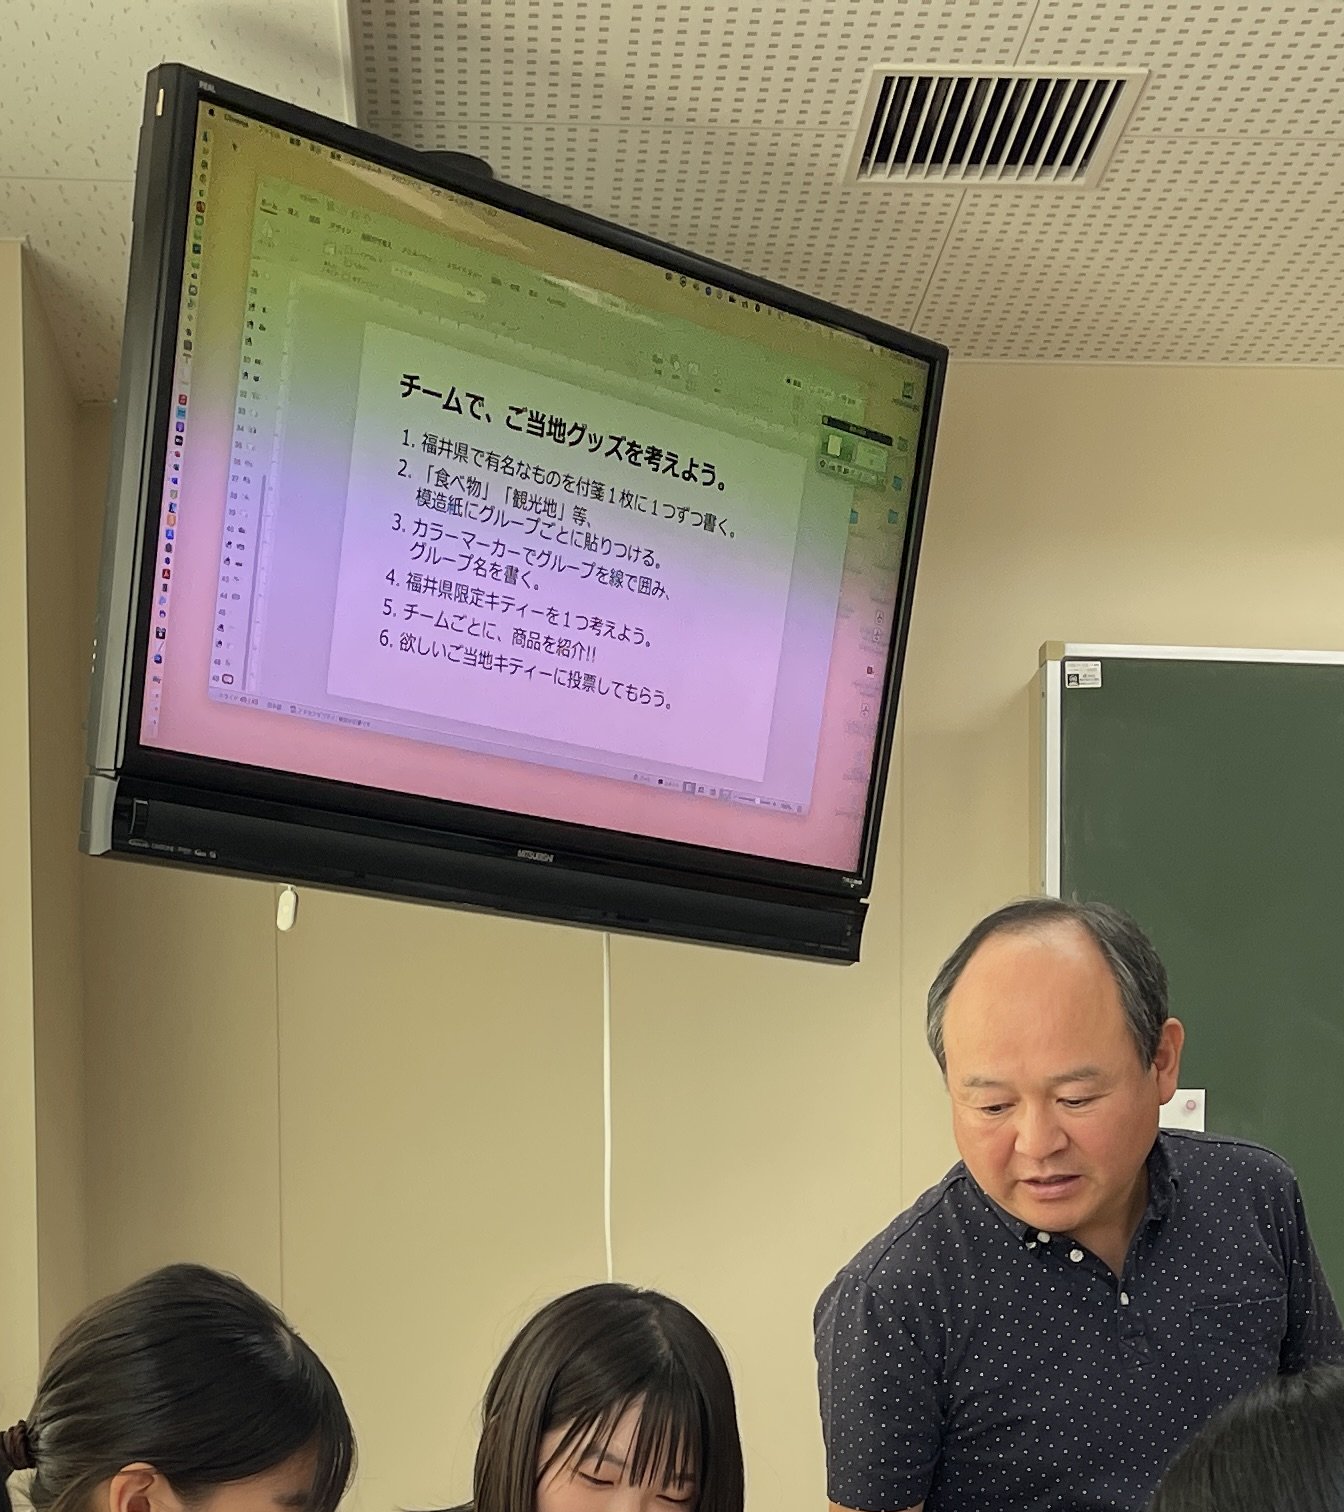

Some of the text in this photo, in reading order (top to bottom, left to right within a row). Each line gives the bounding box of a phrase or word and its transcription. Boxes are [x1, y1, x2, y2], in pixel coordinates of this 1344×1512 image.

[400, 373, 726, 491] チームで、ご当地グッズを考えよう。
[401, 429, 415, 448] 1.
[397, 459, 412, 479] 2.
[415, 487, 661, 569] 模造紙にグループごとに貼りつける。
[385, 569, 399, 588] 4.
[391, 513, 670, 601] 3. カラーマーカーでグループを線で囲み、
[409, 541, 539, 591] グループ名を書く。
[383, 598, 397, 618] 5.
[379, 629, 671, 710] 6. 欲しいご当地キティーに投票してもらう。
